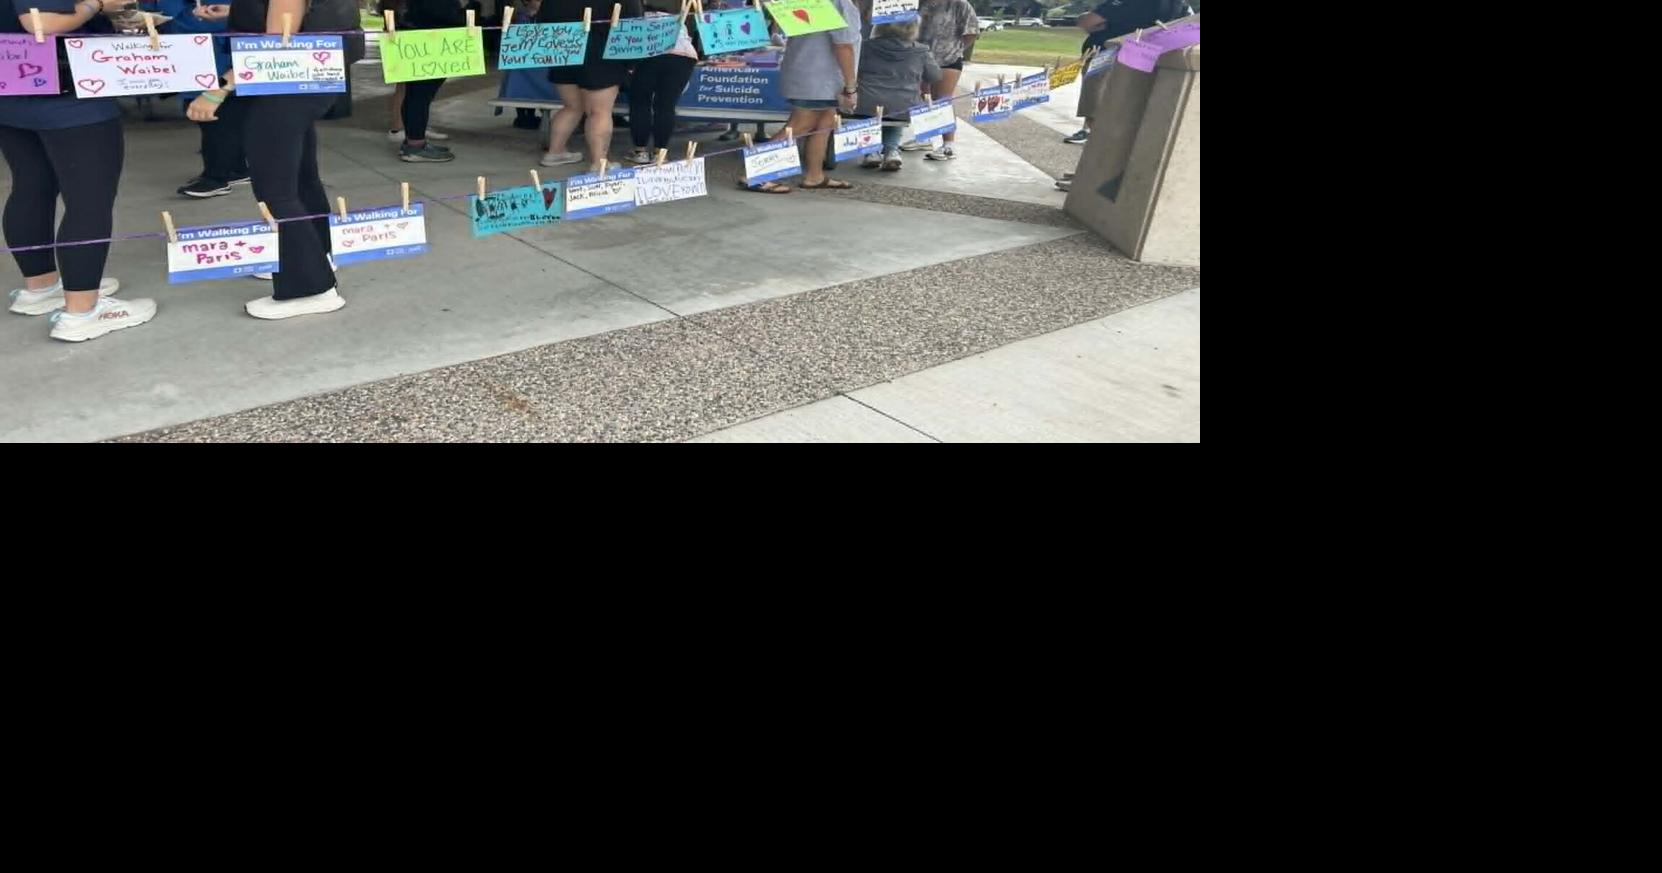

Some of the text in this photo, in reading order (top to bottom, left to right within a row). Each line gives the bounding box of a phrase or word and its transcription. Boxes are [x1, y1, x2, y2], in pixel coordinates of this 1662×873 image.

[236, 39, 337, 50] I'm Waking For
[391, 36, 475, 60] YOU ARE
[91, 49, 168, 63] Graham
[244, 55, 300, 71] Graham
[117, 64, 177, 75] Waibel
[267, 67, 310, 81] Waibel
[700, 74, 769, 84] Foundation
[714, 84, 760, 94] Suicide
[697, 94, 763, 104] Prevention
[355, 209, 398, 221] Walking
[198, 226, 249, 238] Walking
[182, 240, 229, 253] mara
[196, 250, 242, 264] Paris
[98, 310, 129, 321] HOKA
